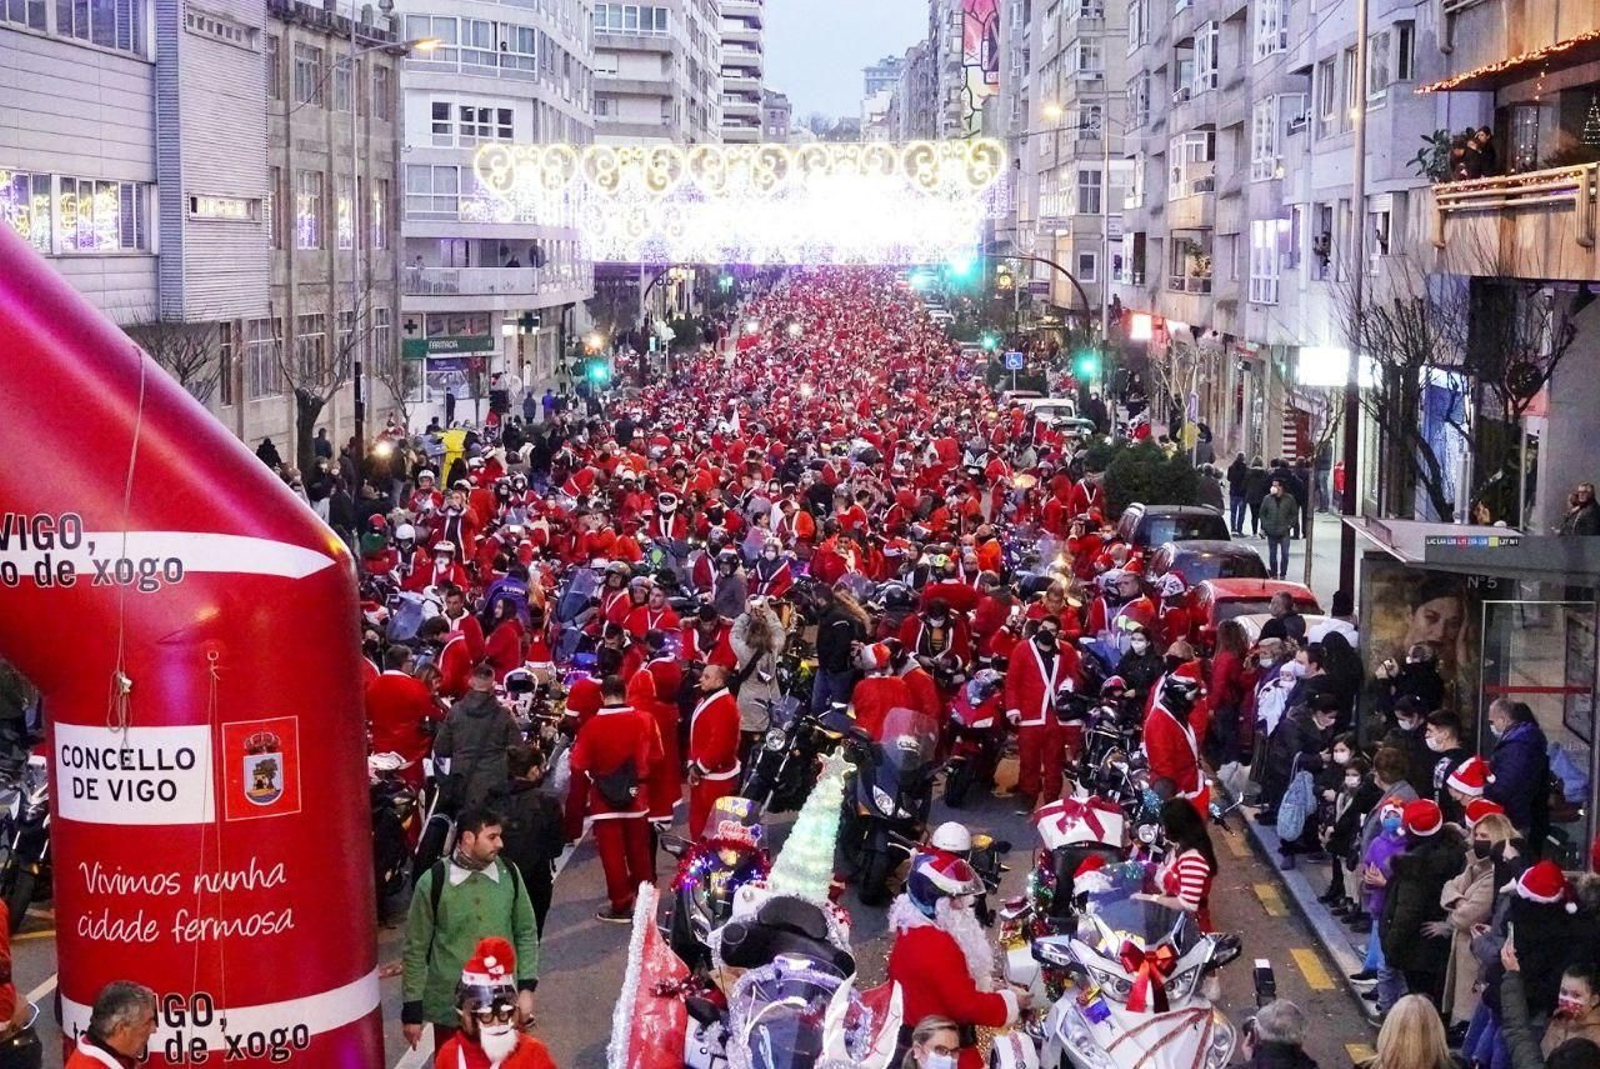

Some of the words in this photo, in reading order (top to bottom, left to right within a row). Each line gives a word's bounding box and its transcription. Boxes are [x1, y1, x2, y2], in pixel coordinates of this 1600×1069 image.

[34, 552, 77, 588] de
[91, 556, 185, 594] xogo
[61, 744, 196, 772] CONCELLO
[72, 776, 99, 801] DE
[107, 778, 178, 802] VIGO
[78, 861, 181, 896] Vivimos
[193, 856, 287, 895] nunha
[77, 908, 160, 943] cidade
[171, 908, 295, 944] fermosa
[165, 1030, 209, 1065] de
[223, 1023, 311, 1064] xogo
